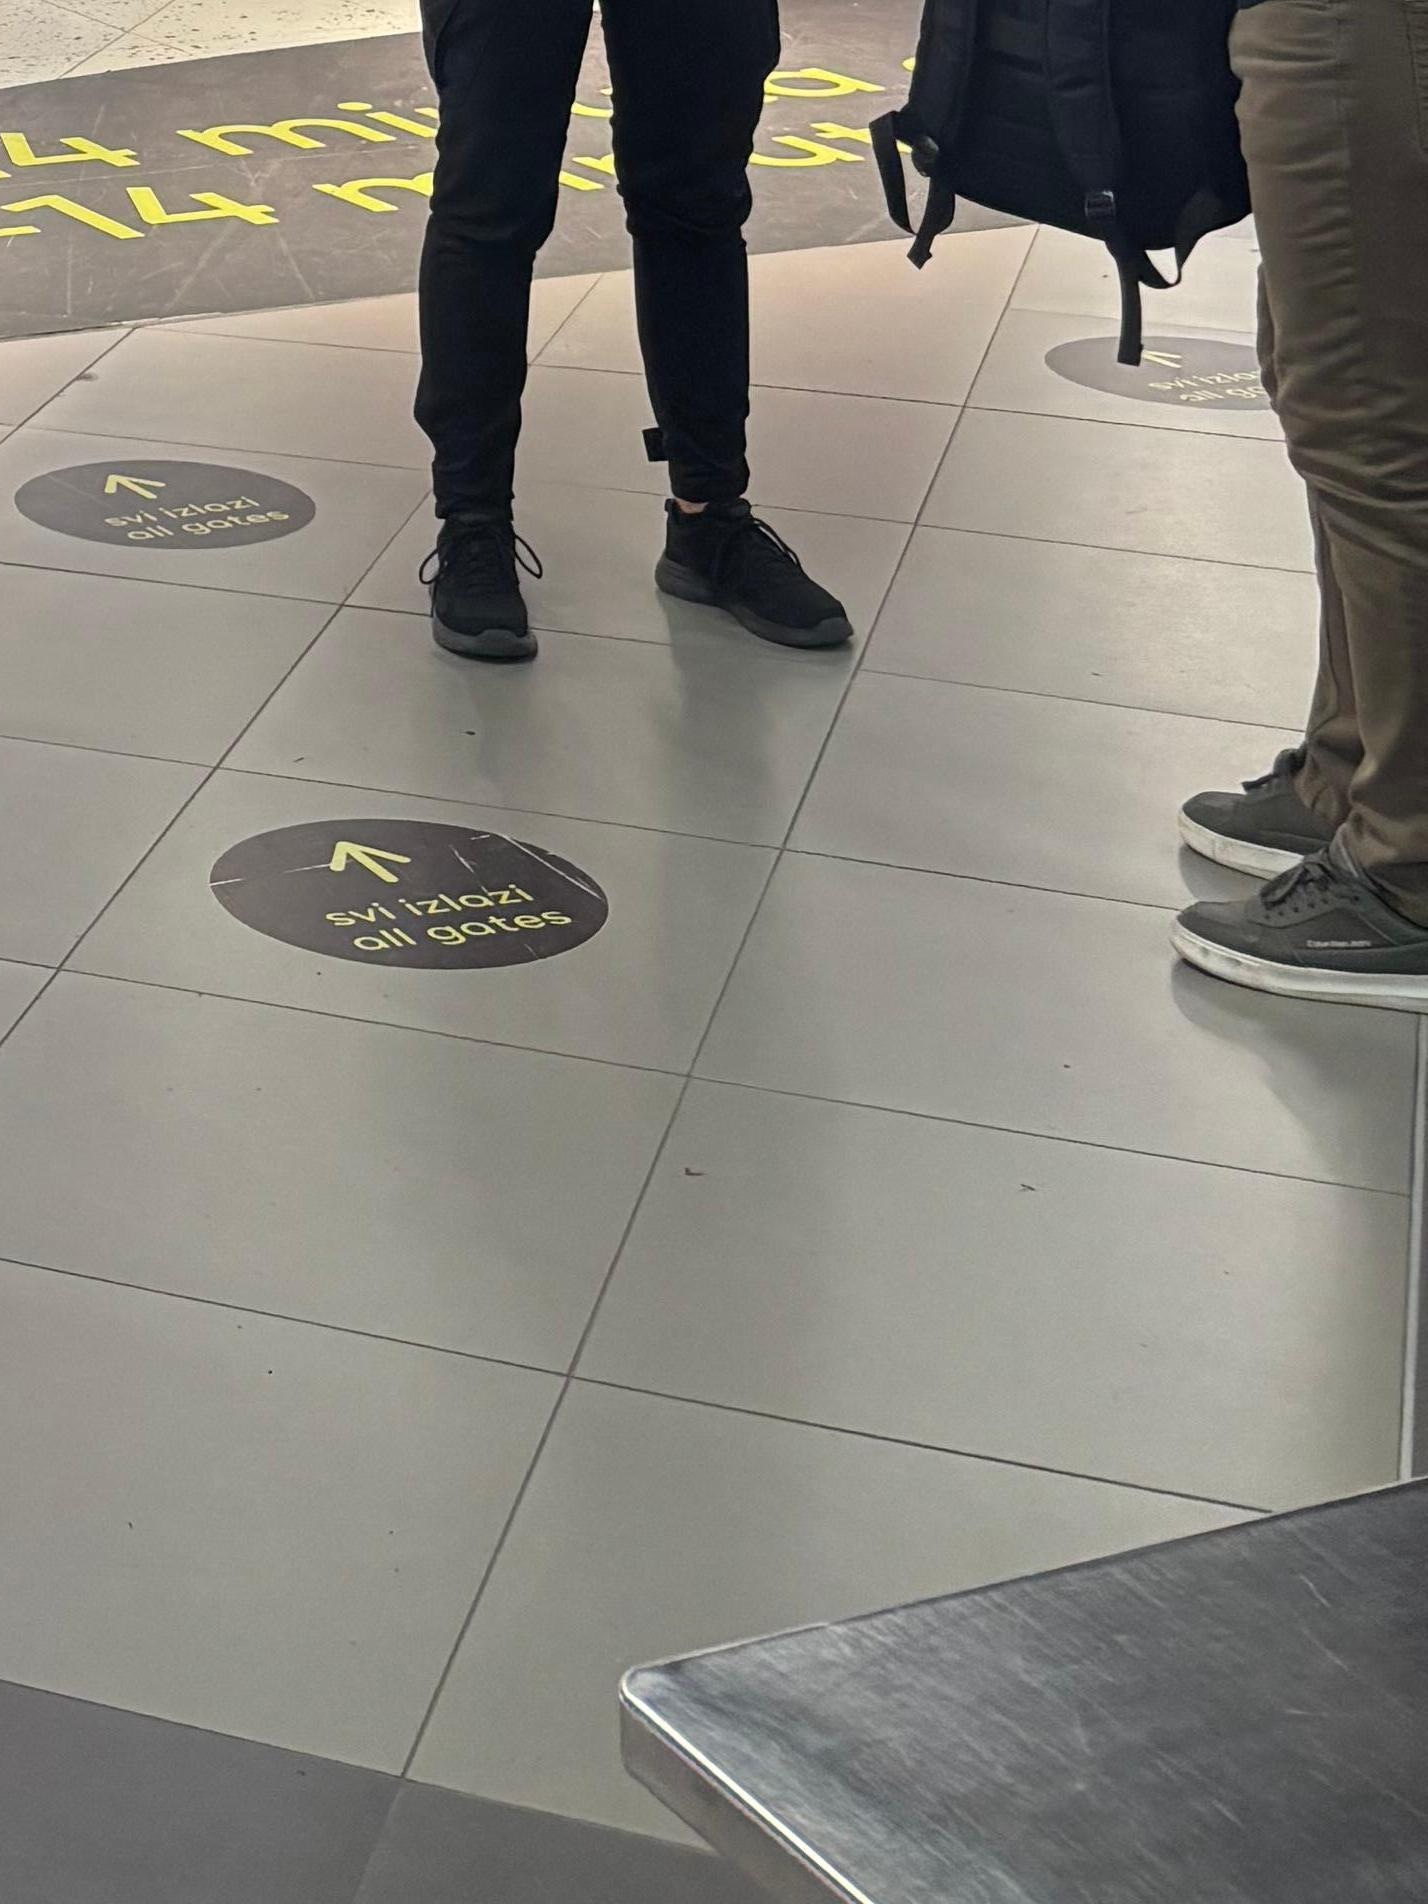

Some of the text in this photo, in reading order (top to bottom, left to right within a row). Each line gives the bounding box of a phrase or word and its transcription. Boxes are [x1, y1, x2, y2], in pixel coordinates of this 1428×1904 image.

[104, 495, 260, 528] svi izlazi
[127, 510, 290, 542] all gates
[325, 883, 535, 927] svi izlazi
[352, 909, 573, 952] all gates
